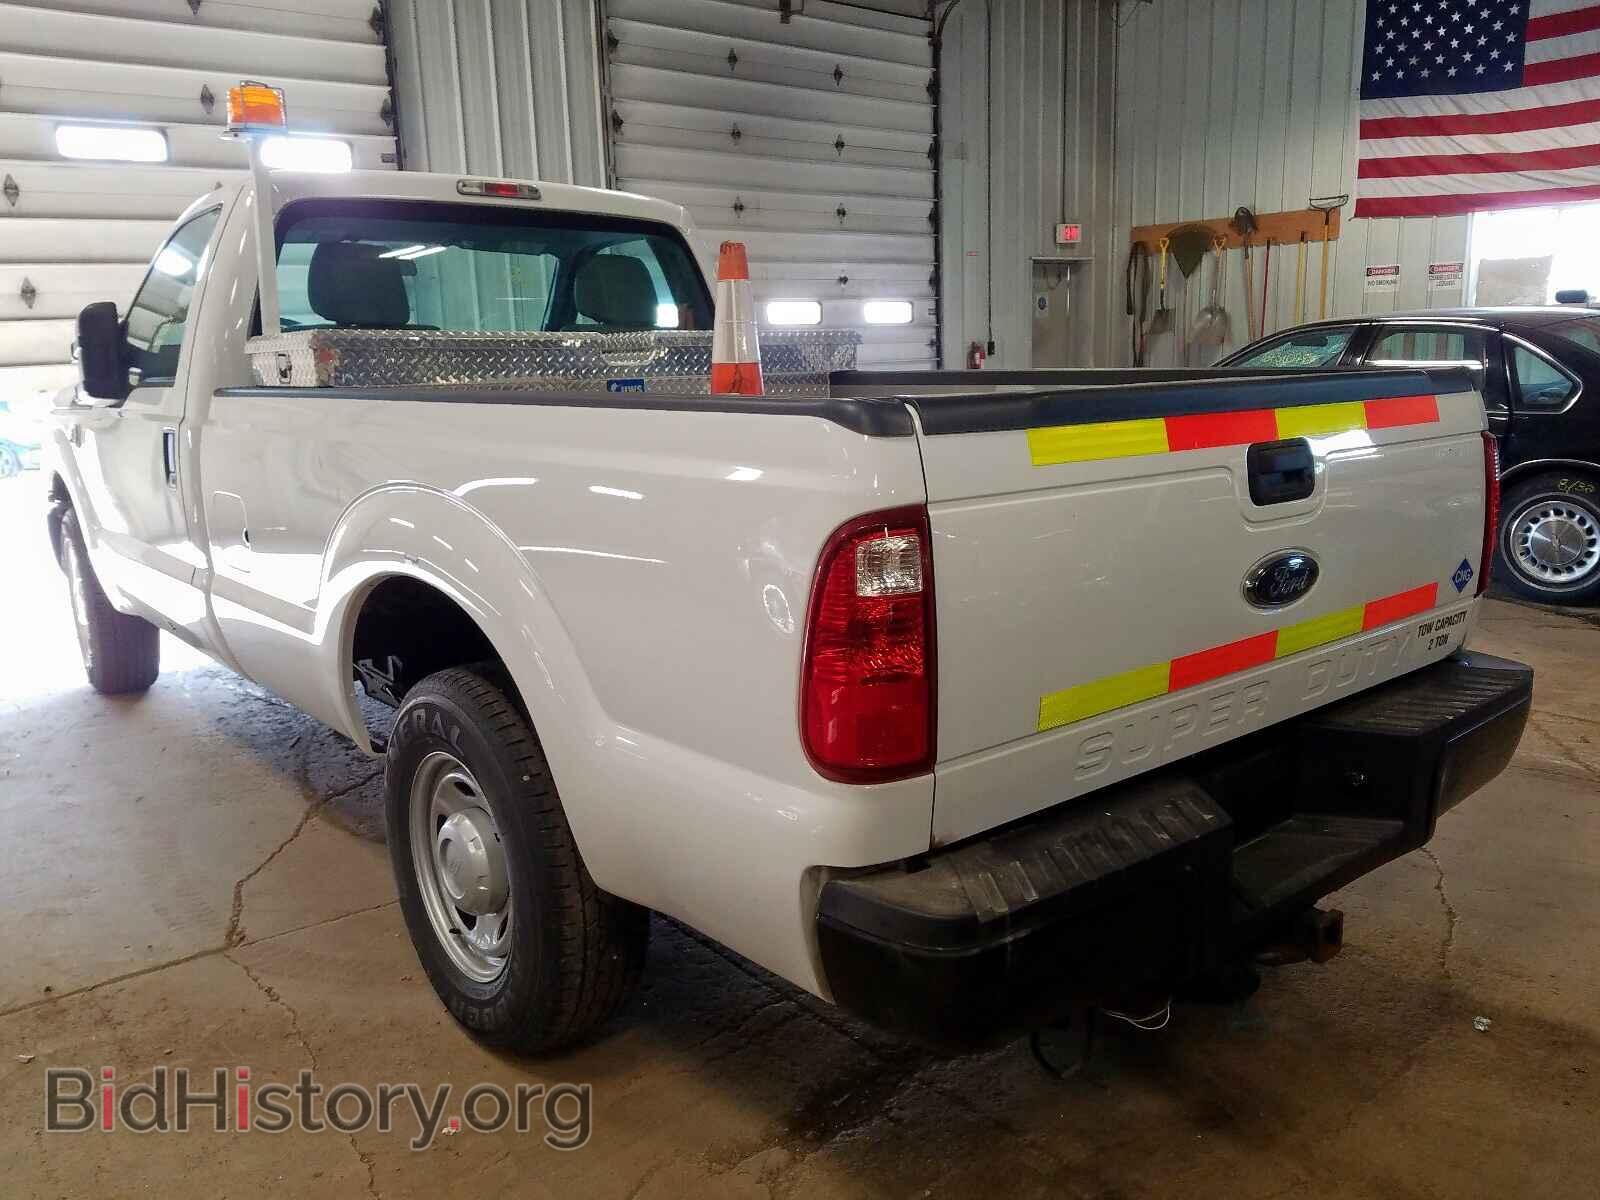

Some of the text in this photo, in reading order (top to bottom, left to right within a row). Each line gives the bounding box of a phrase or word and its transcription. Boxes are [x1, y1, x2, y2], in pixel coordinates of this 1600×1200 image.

[1454, 567, 1471, 583] CNG
[1417, 610, 1468, 639] TOW CAPACITY
[1427, 633, 1449, 651] 2 TON
[1074, 631, 1412, 781] SUPER DUTY
